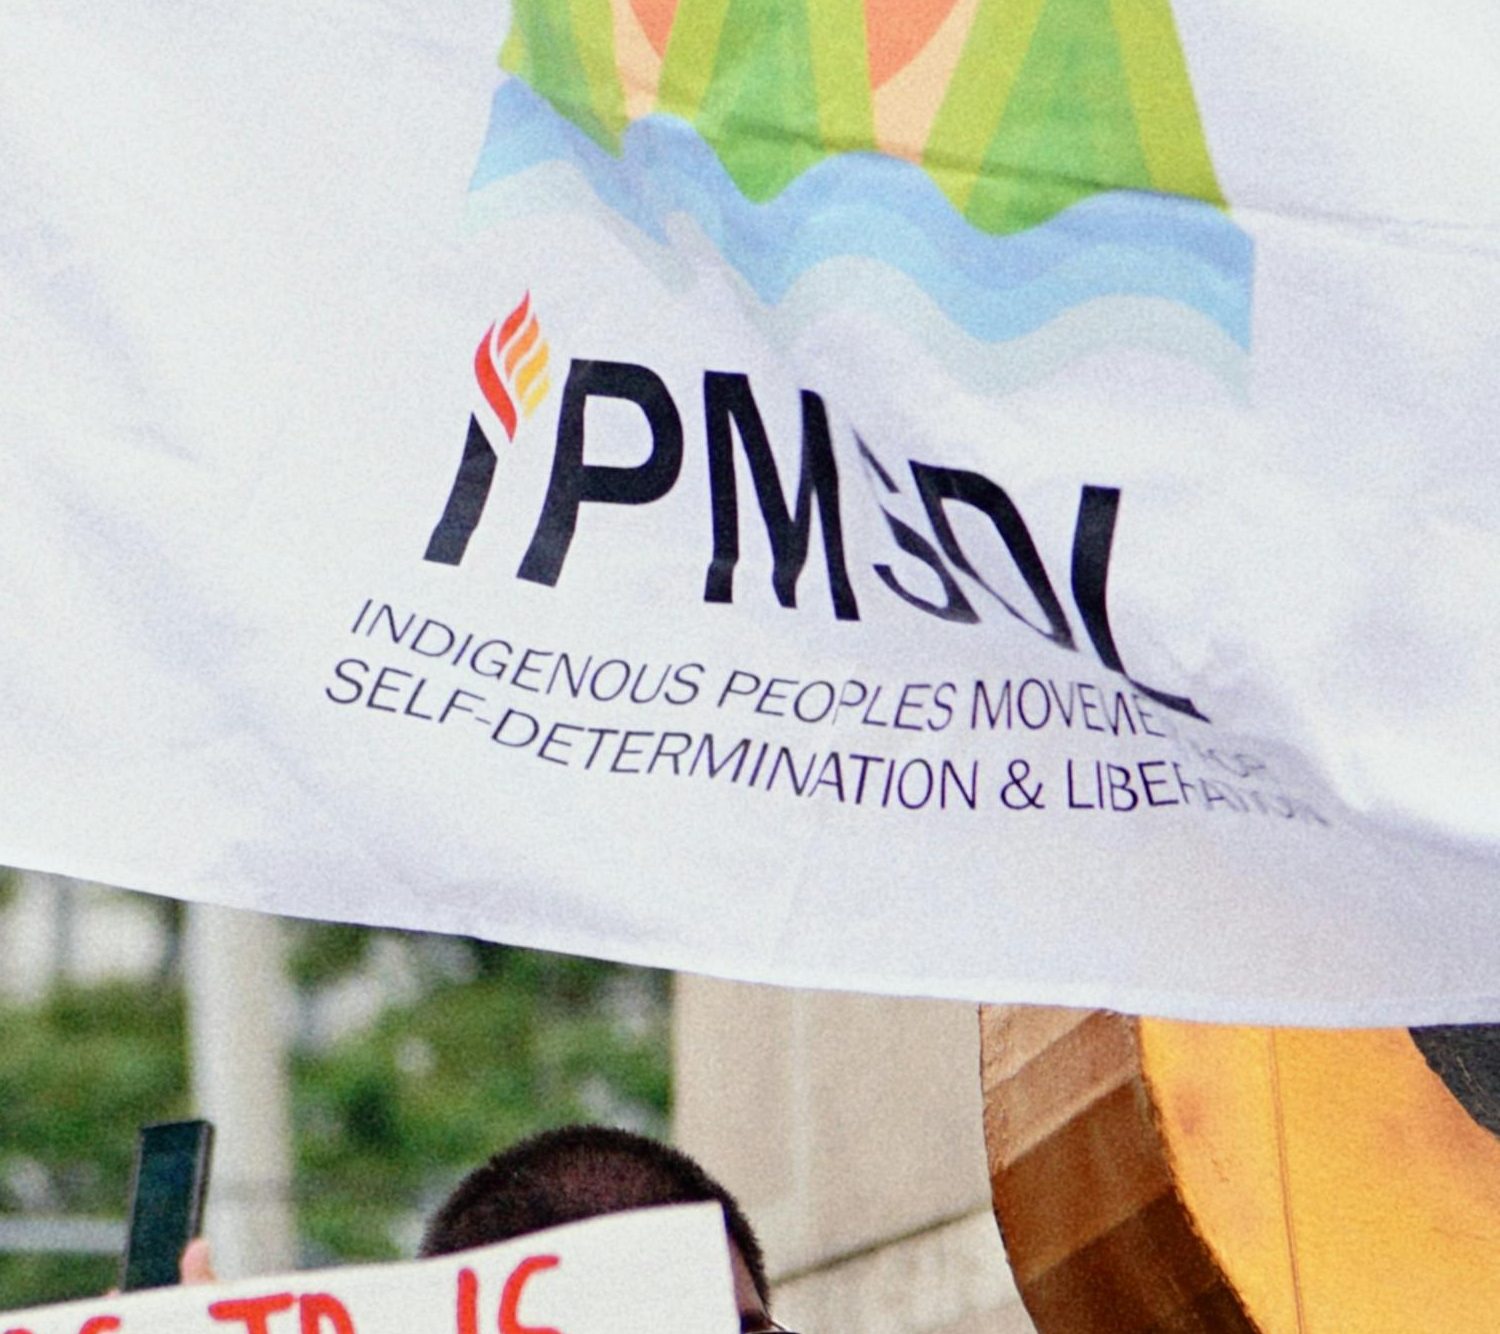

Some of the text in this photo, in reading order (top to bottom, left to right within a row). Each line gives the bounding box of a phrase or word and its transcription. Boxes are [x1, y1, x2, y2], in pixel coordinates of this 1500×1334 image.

[325, 658, 978, 810] SELF-DETERMINATION
[999, 758, 1045, 811] &
[351, 598, 1182, 743] INDIGENOUS PEOPLES MOVEME
